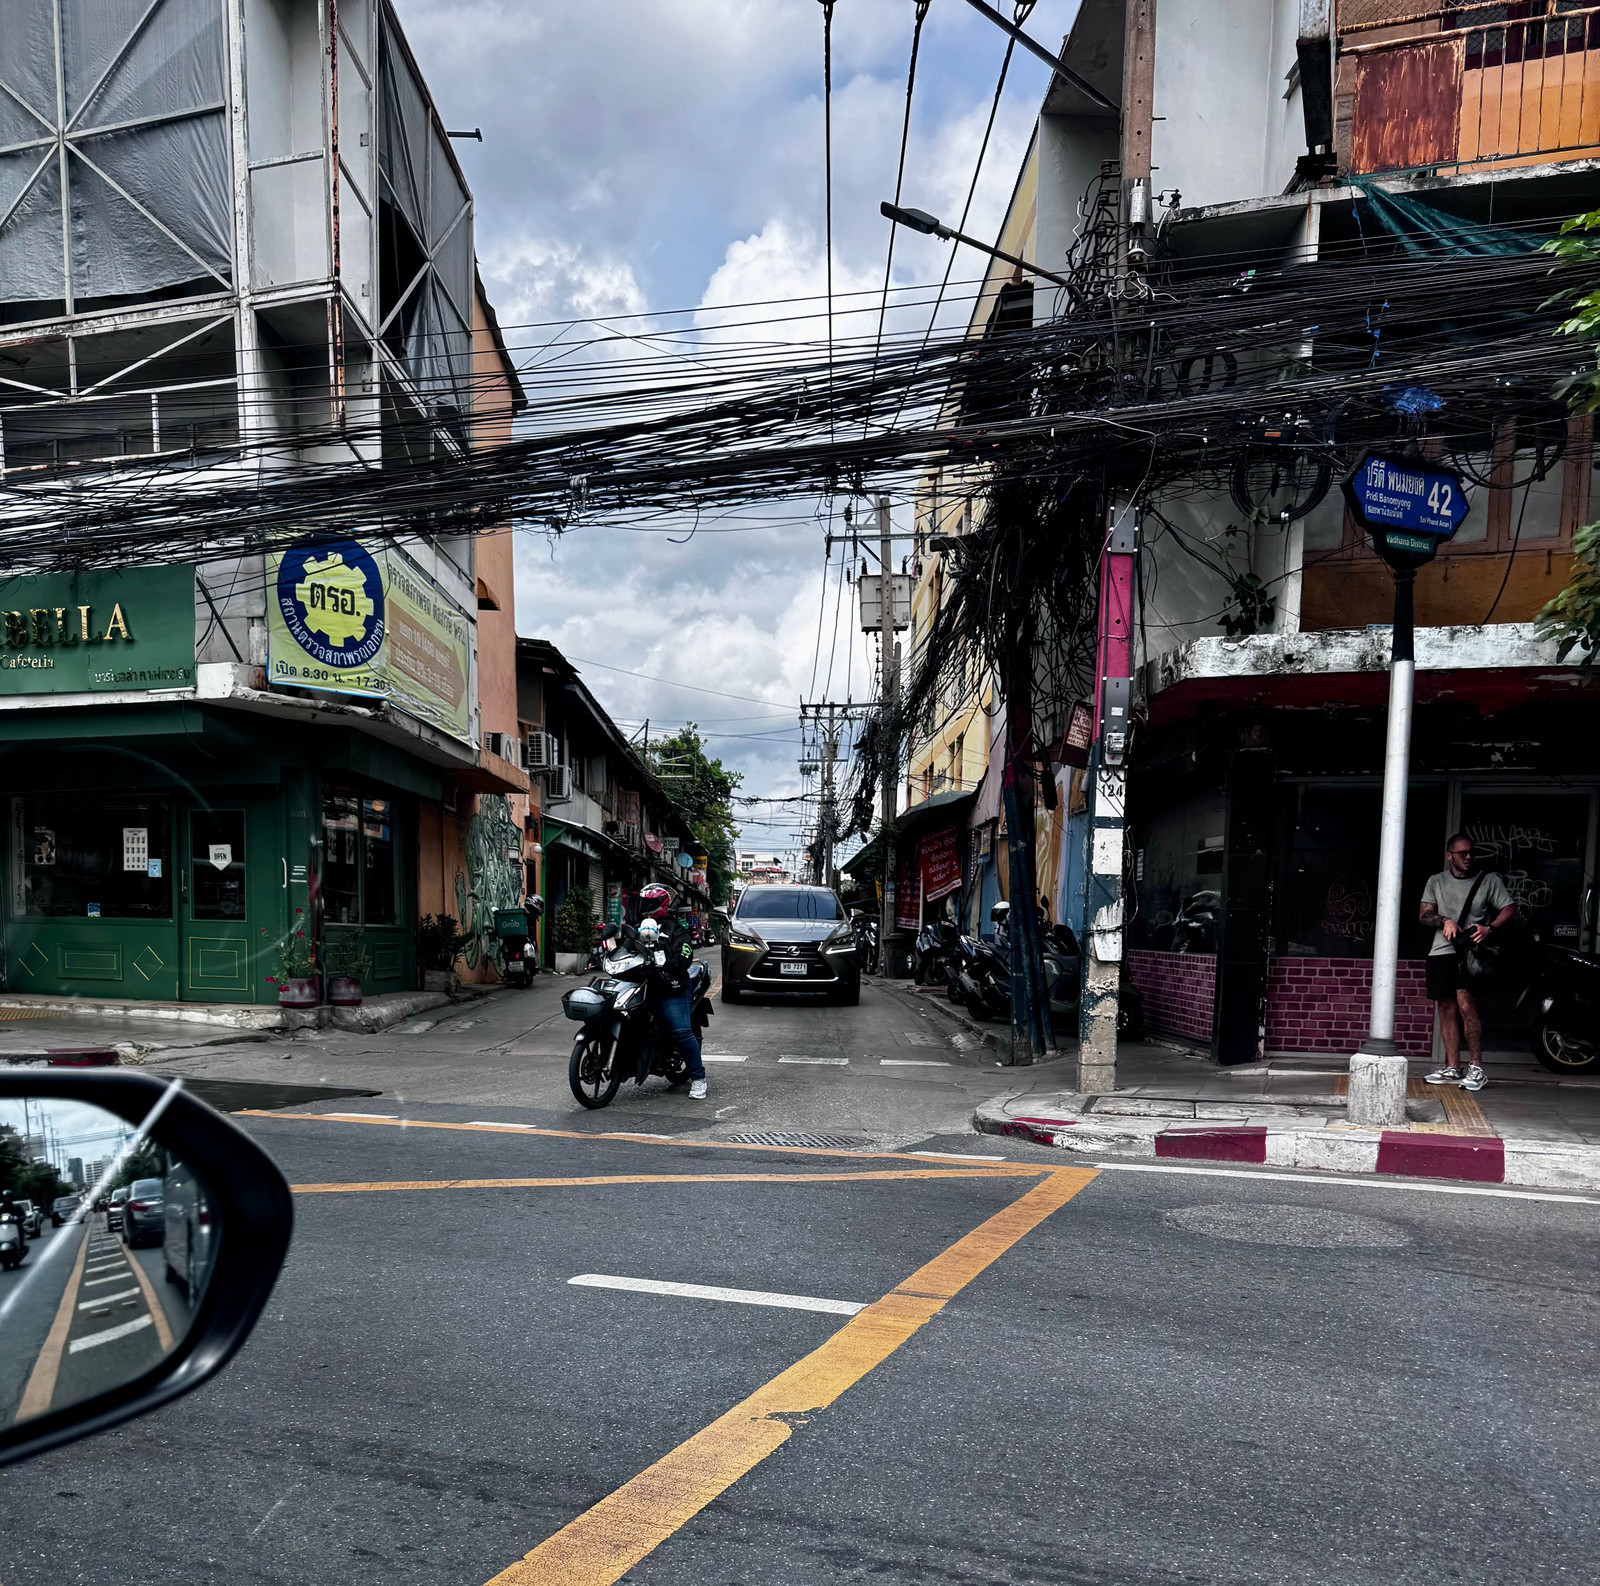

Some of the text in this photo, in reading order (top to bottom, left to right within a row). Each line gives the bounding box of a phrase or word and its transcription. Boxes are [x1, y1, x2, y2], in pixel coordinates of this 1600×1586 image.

[1365, 490, 1411, 511] Pridi Banomyong
[1366, 460, 1386, 488] ปรีดี
[1427, 481, 1452, 517] 42
[1386, 534, 1430, 550] Vadhana District
[309, 581, 361, 617] ตรอ.
[0, 602, 134, 649] BELLA
[281, 597, 385, 666] สถานตรวจสภาพรถเอกชน
[275, 660, 297, 676] เปิด
[302, 667, 328, 681] 8.30
[356, 675, 386, 690] 17.30
[1101, 784, 1123, 798] 124
[213, 852, 227, 860] OPEN
[501, 919, 520, 928] Grab
